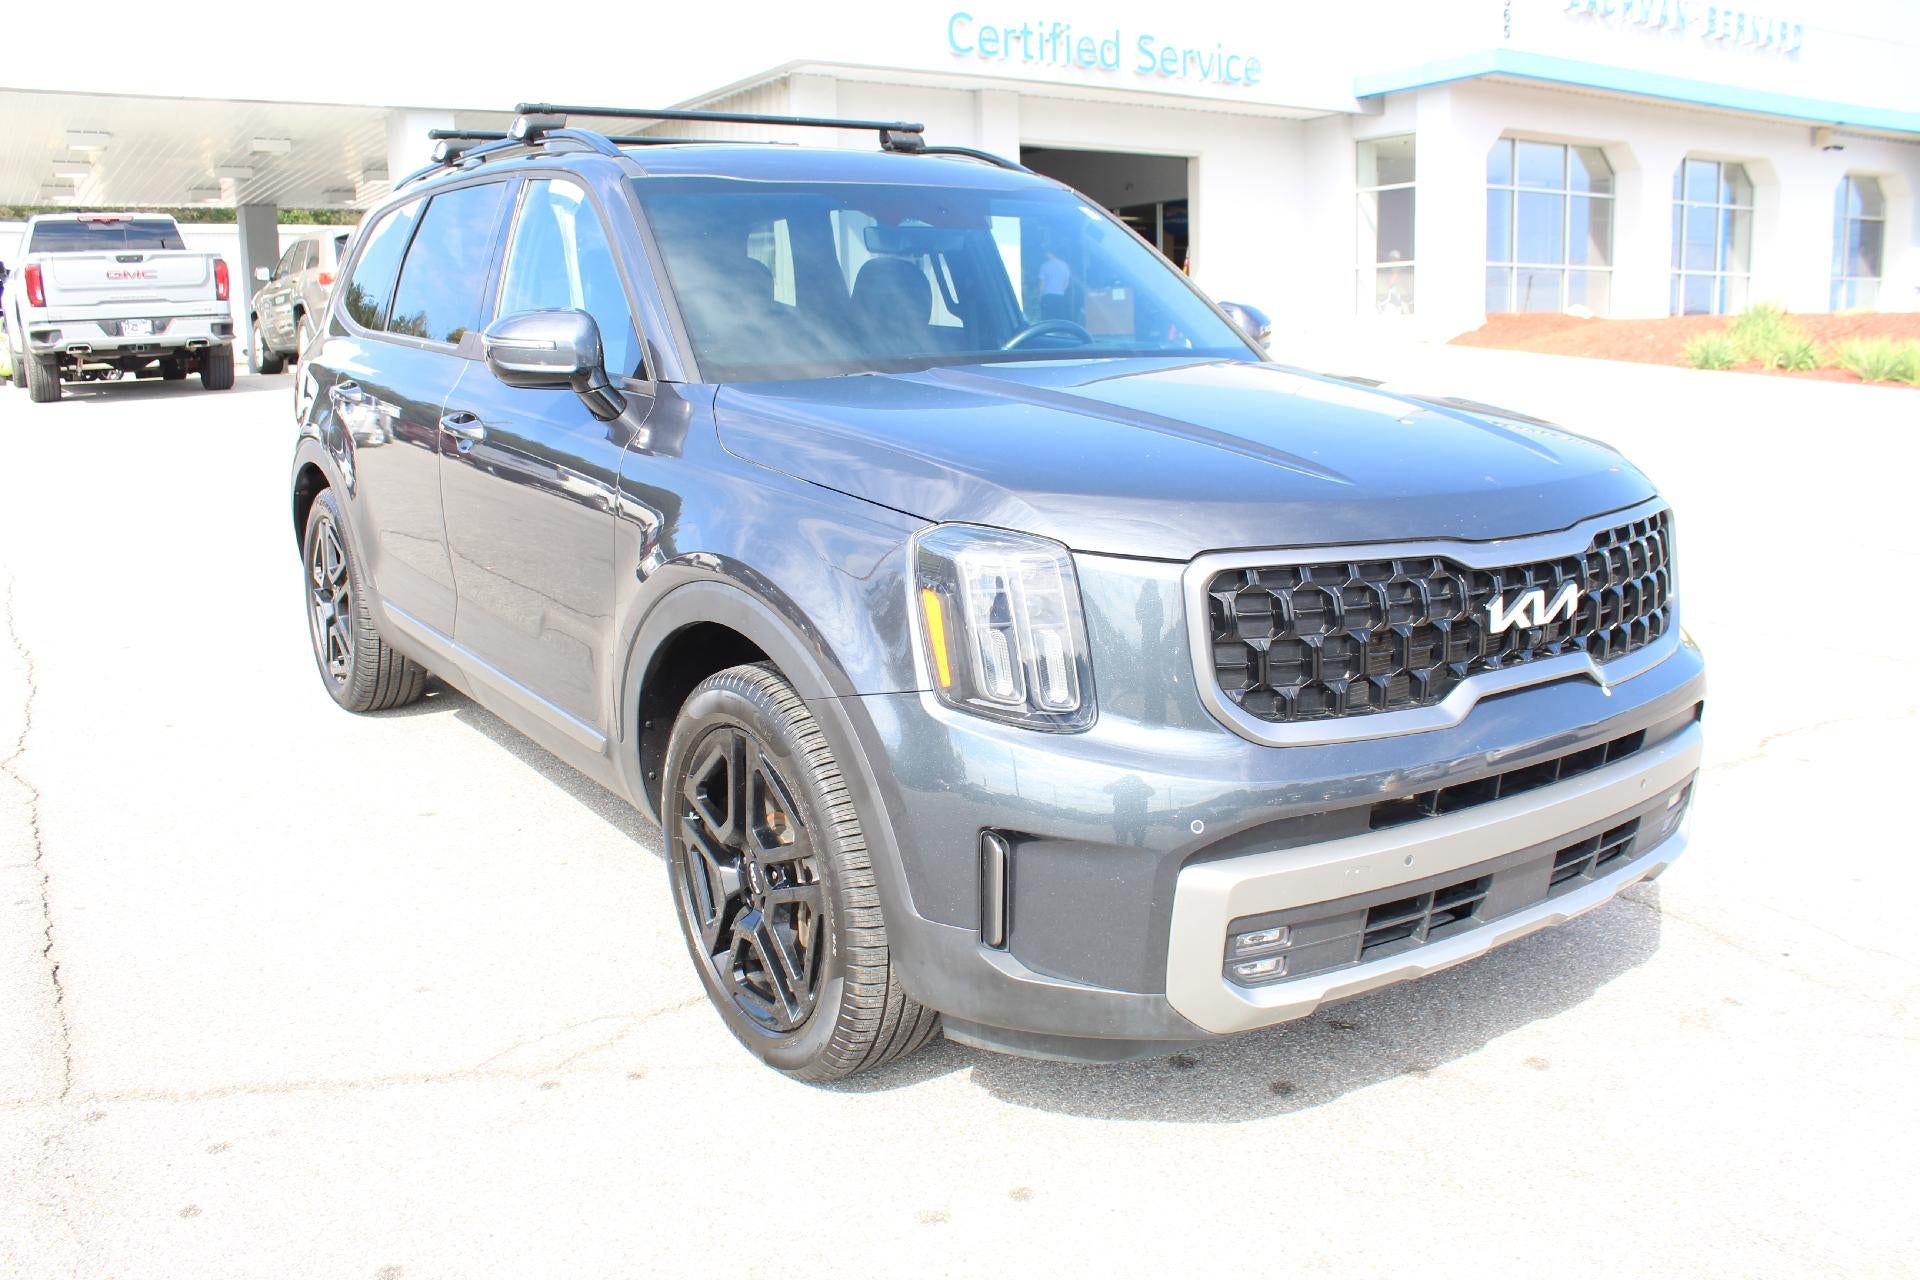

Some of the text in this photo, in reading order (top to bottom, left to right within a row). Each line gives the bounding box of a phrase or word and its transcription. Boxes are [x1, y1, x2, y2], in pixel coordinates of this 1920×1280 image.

[947, 11, 1262, 84] Certified Service
[106, 270, 158, 280] GMC
